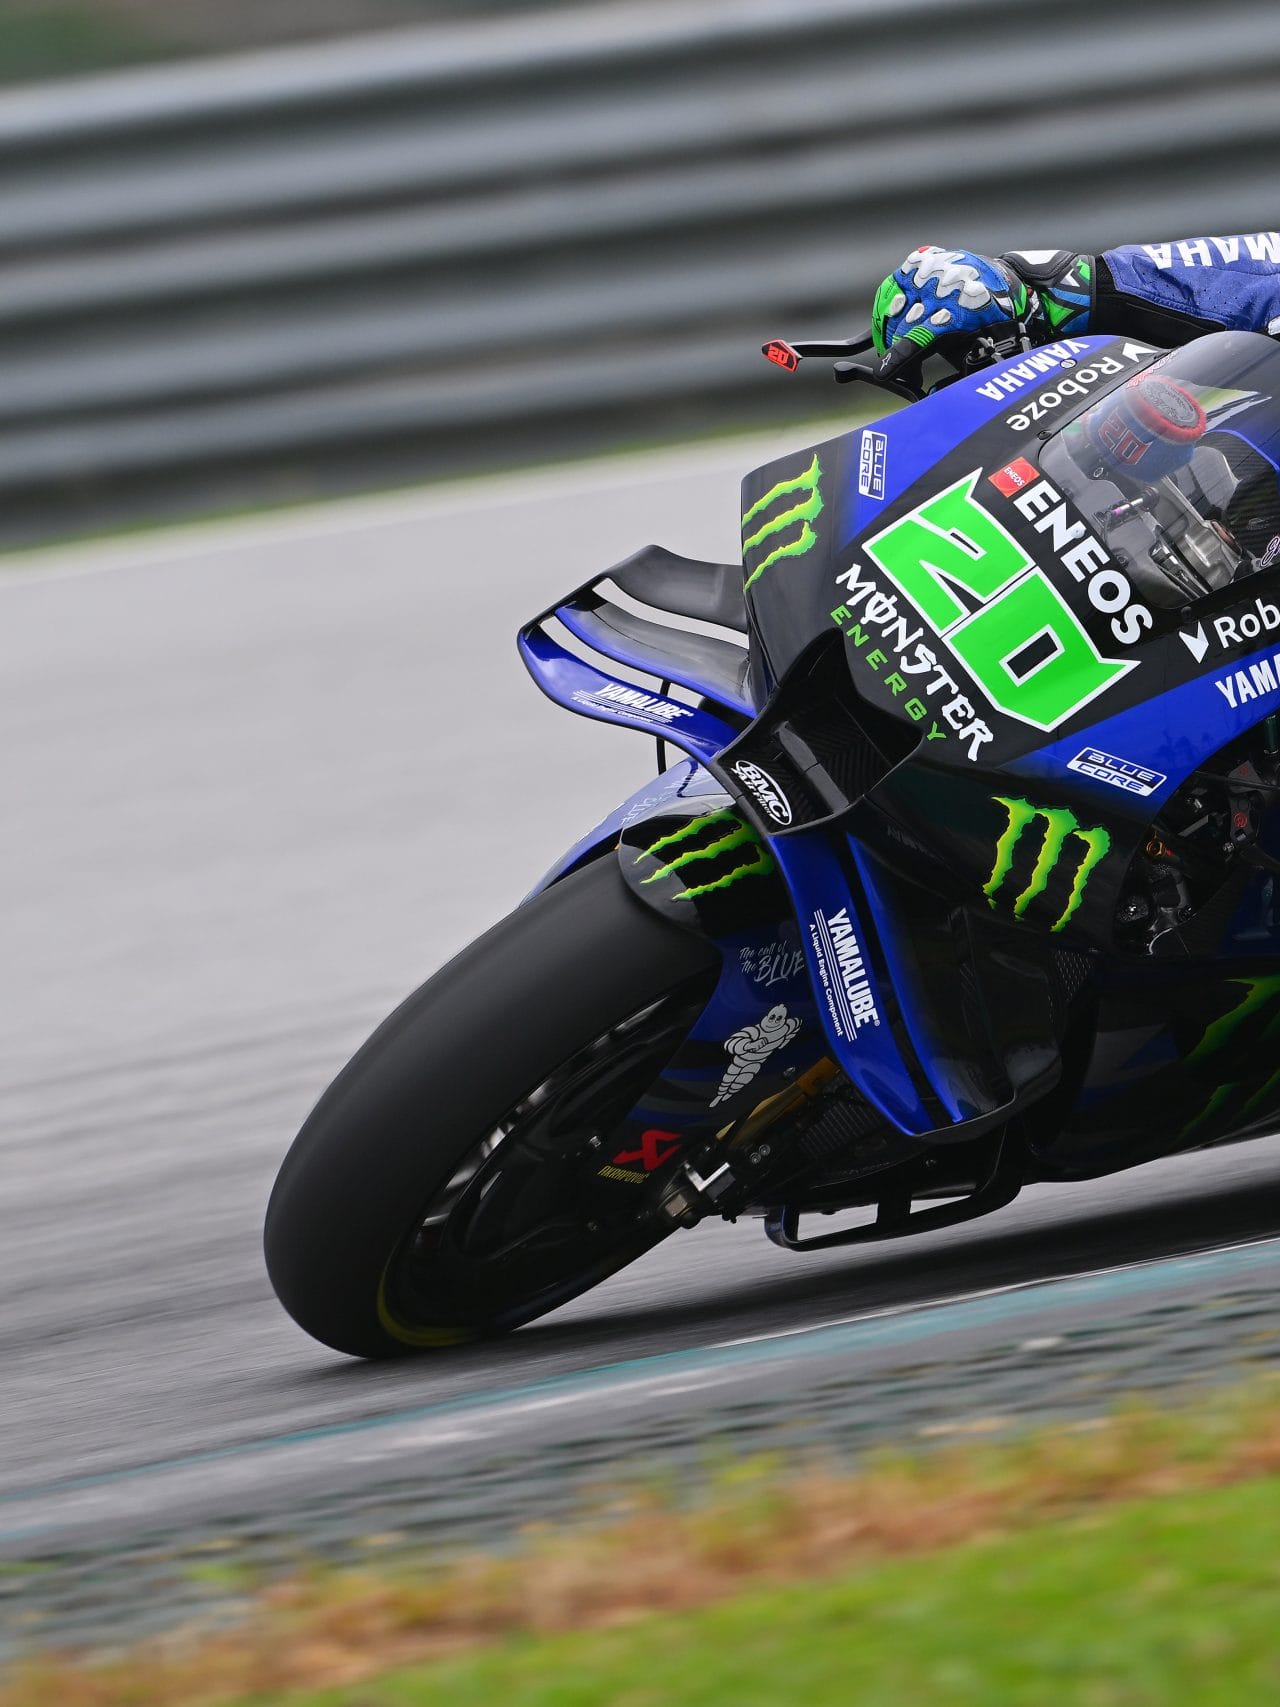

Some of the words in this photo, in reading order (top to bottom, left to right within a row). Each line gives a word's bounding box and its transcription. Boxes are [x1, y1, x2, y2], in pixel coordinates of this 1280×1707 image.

[768, 345, 788, 362] 20
[976, 340, 1090, 401] YAMAHA
[1006, 357, 1124, 430] Roboze
[861, 437, 871, 488] CORE
[873, 439, 884, 492] BLUE
[1004, 465, 1026, 487] ENEOS
[1013, 480, 1153, 644] ENEOS
[862, 466, 1142, 733] 20
[831, 605, 946, 742] ENERGY
[836, 563, 993, 760] MONSTER
[596, 683, 689, 719] YAMALUBE
[739, 766, 789, 817] BMC
[1078, 763, 1144, 792] CORE
[1087, 752, 1157, 781] BLUE
[754, 950, 805, 986] BLUE
[812, 932, 823, 957] Liquid
[819, 959, 829, 987] Engine
[825, 988, 844, 1037] Component
[828, 908, 879, 1028] YAMALUBE
